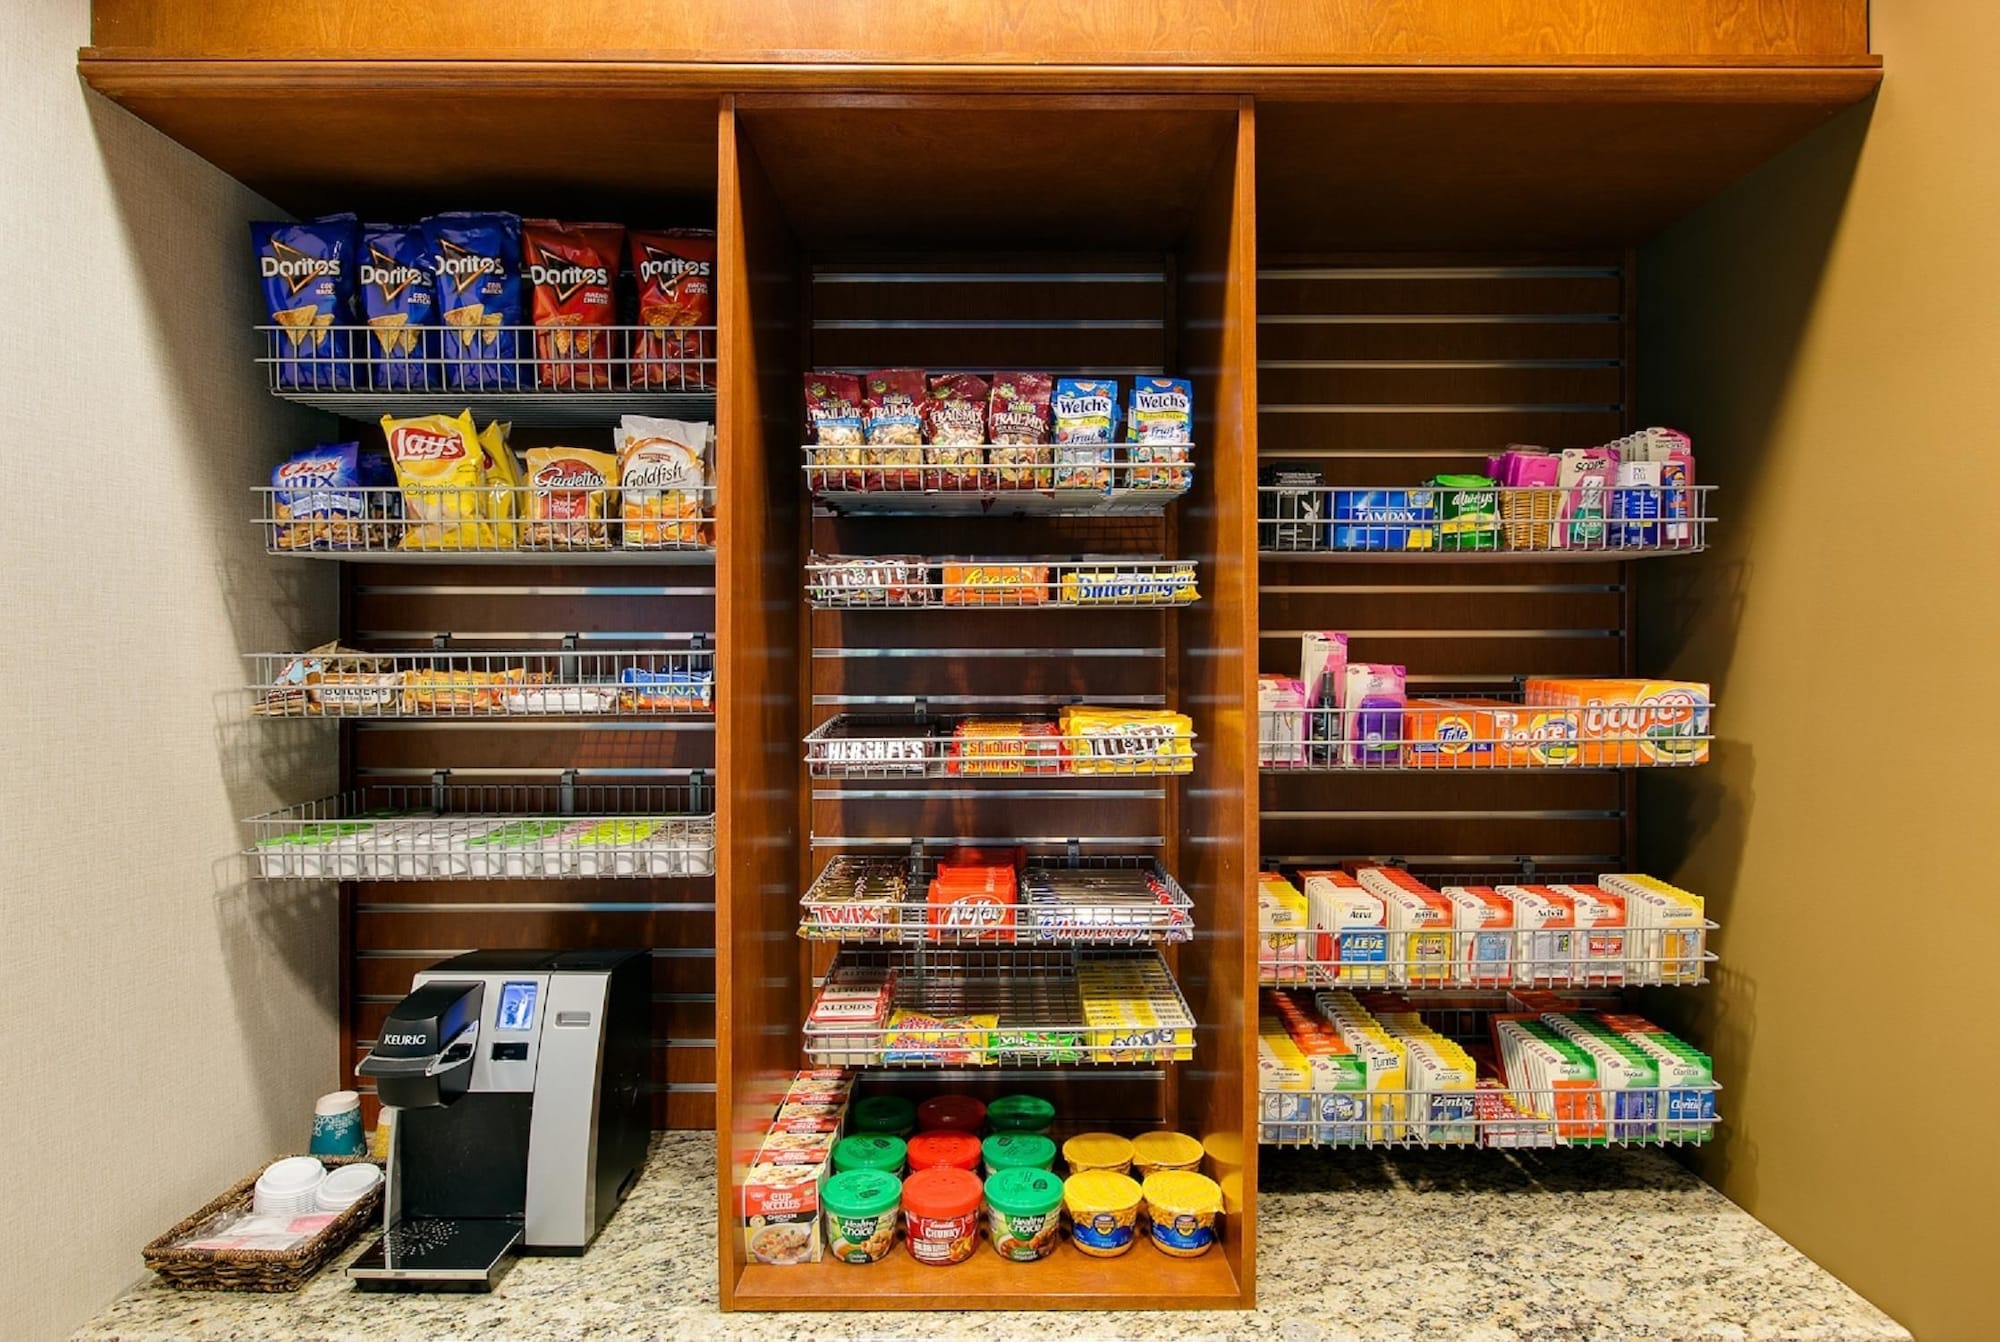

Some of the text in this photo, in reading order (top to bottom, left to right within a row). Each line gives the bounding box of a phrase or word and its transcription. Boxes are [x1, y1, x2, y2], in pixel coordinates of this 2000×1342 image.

[261, 257, 341, 277] Doritos
[434, 255, 504, 276] Doritos
[640, 258, 711, 283] Doritos
[360, 265, 433, 287] Doritos
[530, 265, 608, 287] Doritos
[1060, 399, 1109, 414] Welch's
[1140, 393, 1186, 408] Welch's
[1151, 427, 1174, 437] Fruit
[1575, 460, 1607, 472] SCOPE
[624, 460, 683, 489] Goldfish
[646, 686, 699, 696] LUNA
[1586, 698, 1691, 732] bounce
[1437, 726, 1469, 742] Tide
[1342, 937, 1385, 950] ALEVE
[828, 986, 878, 994] ALTOIDS
[820, 1003, 874, 1012] ALTOIDS
[383, 1034, 427, 1046] KEURIG
[844, 1219, 877, 1229] Healthy
[1012, 1216, 1045, 1226] Healthy
[841, 1225, 874, 1237] Choice
[1008, 1223, 1042, 1233] Choice
